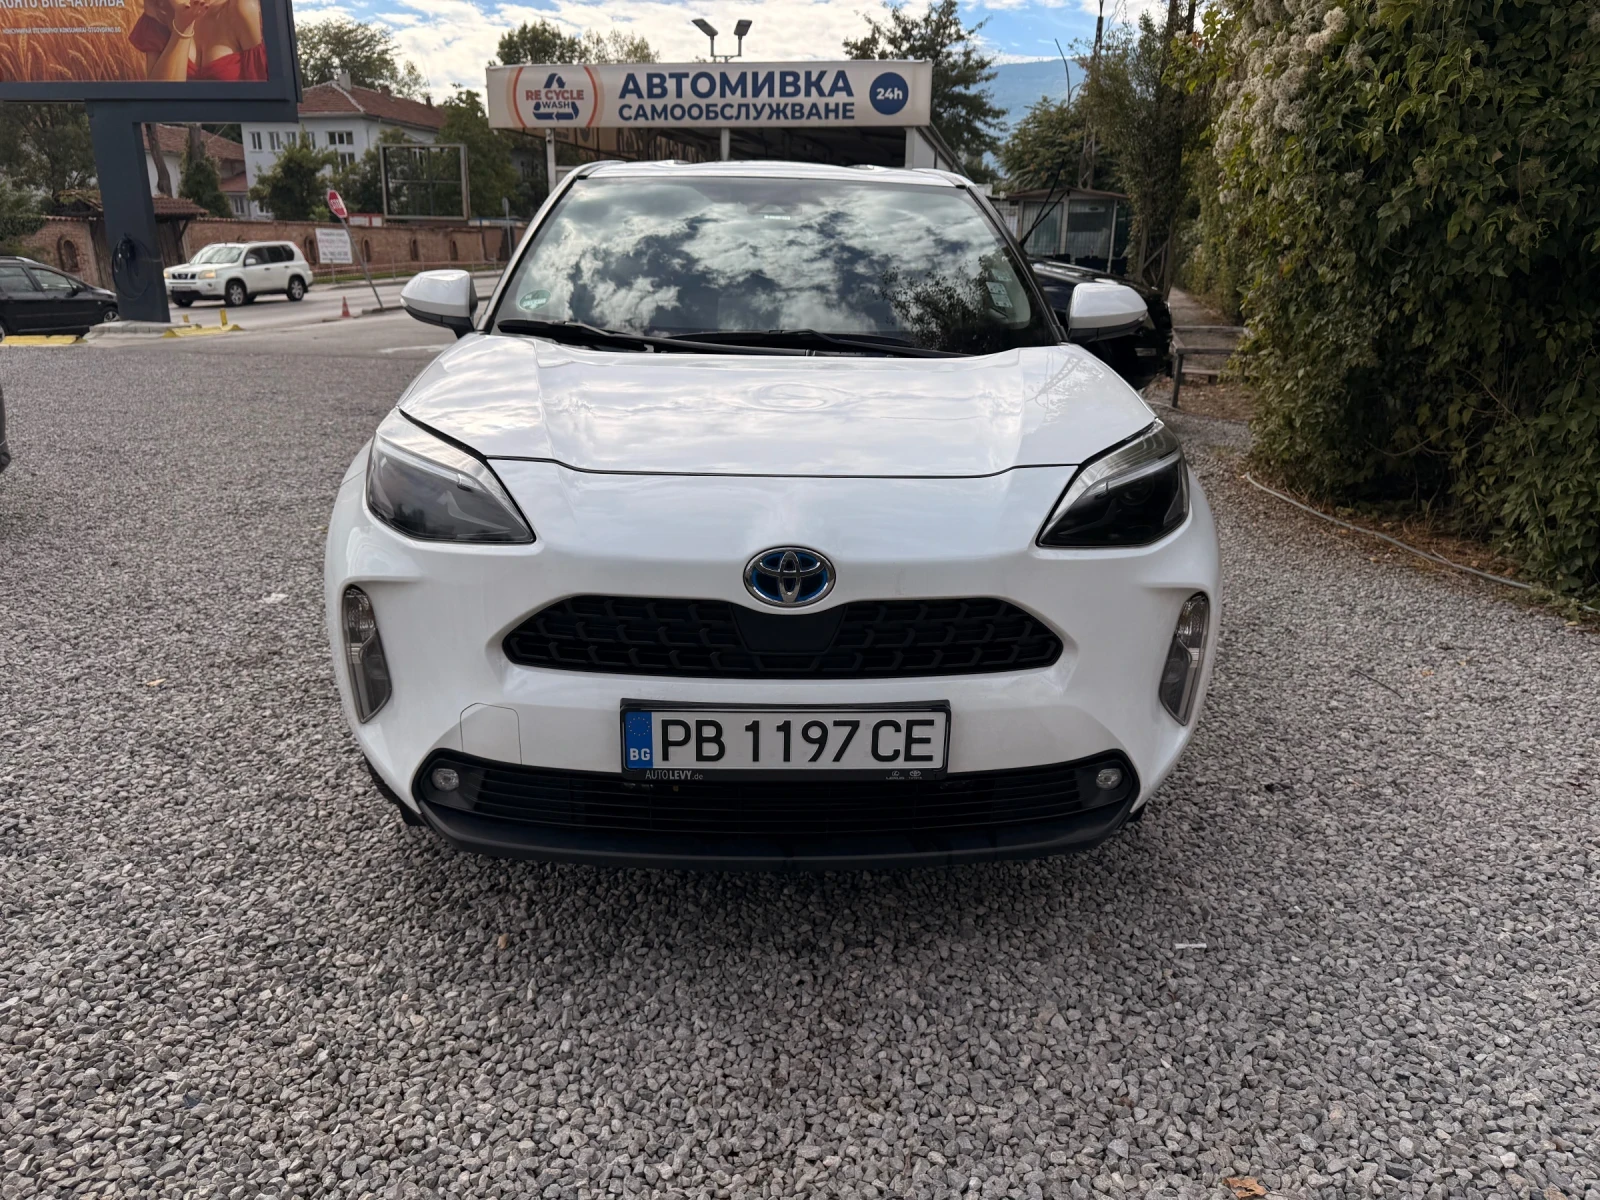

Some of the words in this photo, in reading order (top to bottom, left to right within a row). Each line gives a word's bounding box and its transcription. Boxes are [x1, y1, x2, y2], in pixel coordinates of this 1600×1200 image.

[618, 70, 855, 99] АВТОМИВКА
[525, 89, 542, 101] RE
[545, 89, 584, 101] CYCLE
[876, 87, 903, 100] 24h
[541, 101, 570, 109] WASH
[618, 102, 855, 121] САМООБСЛУЖВАНЕ
[661, 719, 726, 762] PB
[744, 719, 861, 762] 1197
[871, 719, 935, 762] CE
[629, 748, 651, 761] BG
